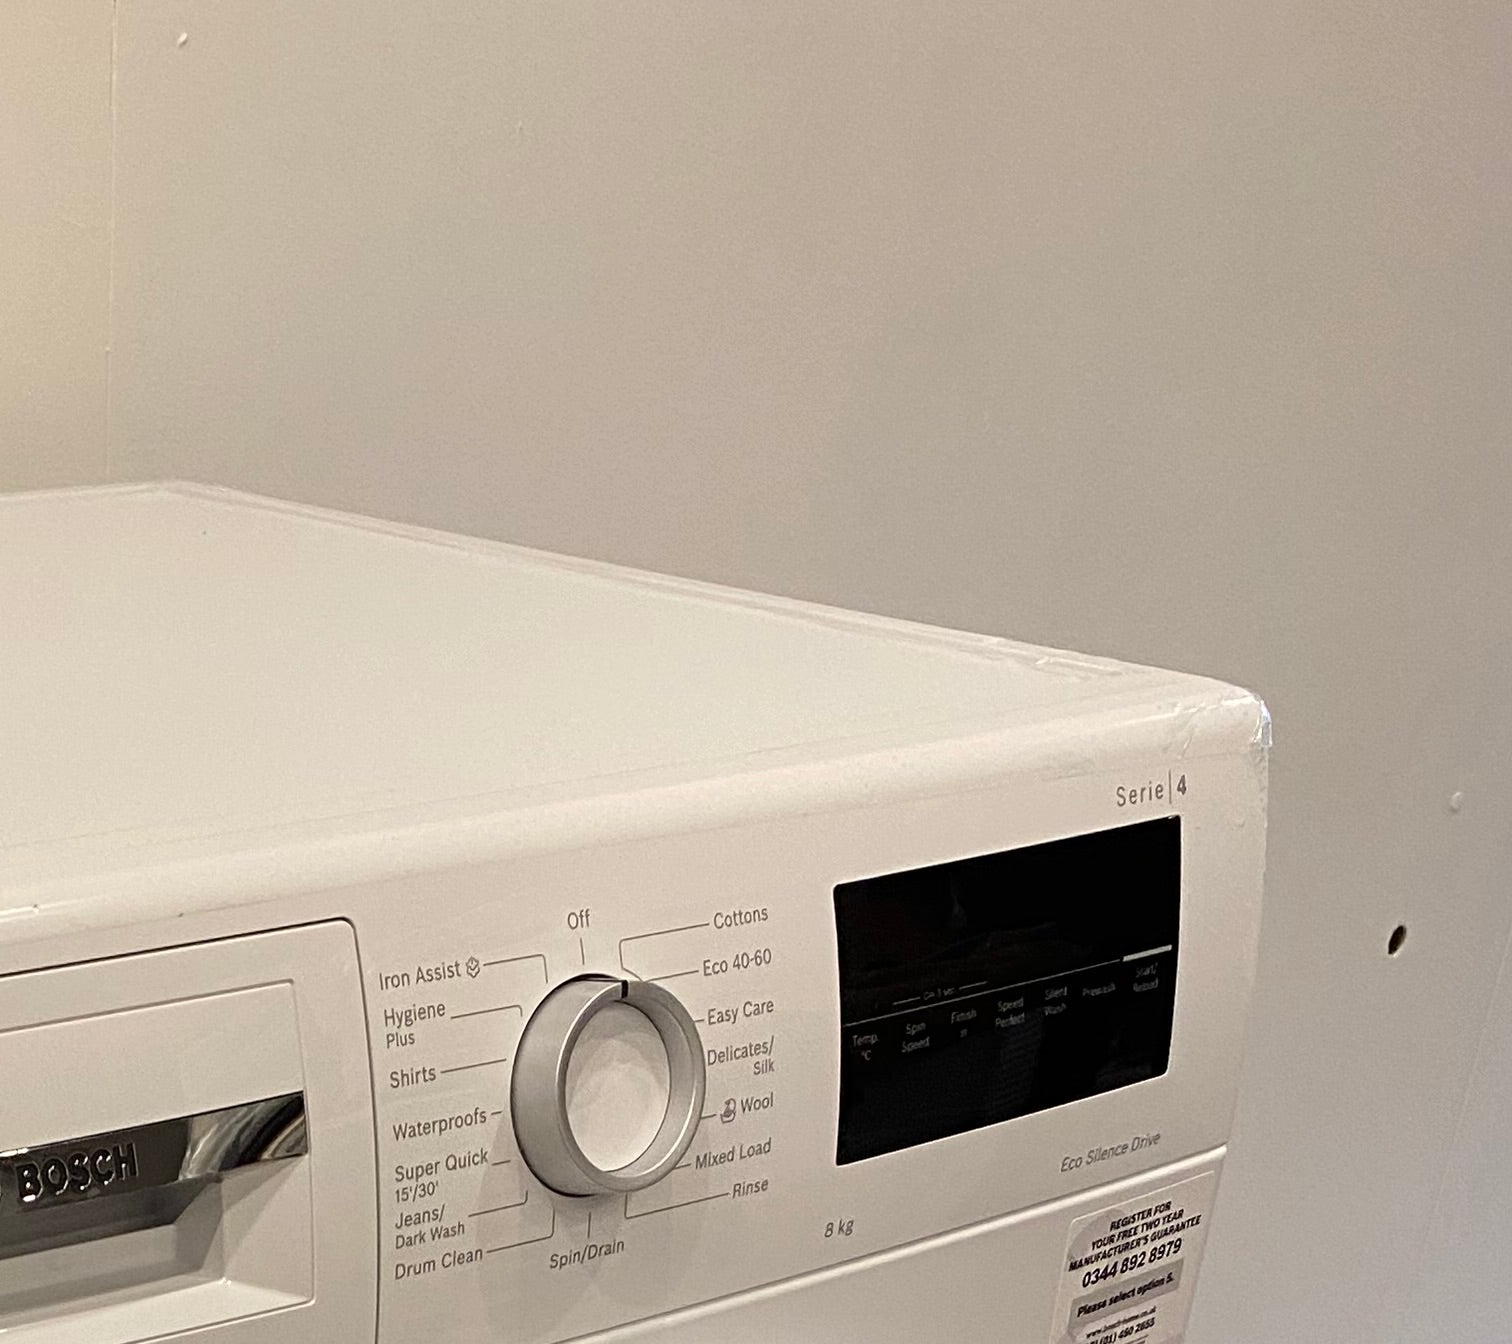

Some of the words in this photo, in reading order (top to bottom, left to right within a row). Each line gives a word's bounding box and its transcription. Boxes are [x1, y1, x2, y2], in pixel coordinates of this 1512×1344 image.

[567, 910, 591, 931] Off
[712, 907, 769, 930] Cottons
[379, 969, 412, 991] Iron
[415, 961, 462, 983] Assist
[702, 957, 729, 977] Eco
[732, 949, 772, 971] 40-60
[383, 1003, 446, 1028] Hygiene
[707, 1007, 739, 1026] Easy
[743, 999, 775, 1018] Care
[386, 1031, 416, 1049] Plus
[706, 1035, 775, 1067] Delicates/
[389, 1065, 436, 1089] Shirts
[753, 1059, 775, 1076] Silk
[740, 1092, 774, 1114] Wool
[392, 1107, 487, 1142] Waterproofs
[395, 1162, 440, 1184] Super
[445, 1147, 489, 1172] Quick
[695, 1148, 735, 1171] Mixed
[739, 1139, 772, 1161] Load
[1060, 1155, 1083, 1174] Eco
[1086, 1141, 1128, 1166] Silence
[1131, 1130, 1161, 1153] Drive
[14, 1142, 138, 1205] BOSCH
[731, 1177, 769, 1199] Rinse
[395, 1205, 445, 1229] Jeans/
[824, 1220, 834, 1238] 8
[837, 1218, 854, 1237] kg
[1091, 1233, 1115, 1251] YOUR
[1116, 1224, 1139, 1239] FREE
[1140, 1217, 1159, 1233] TWO
[1159, 1209, 1184, 1225] YEAR
[1110, 1210, 1151, 1232] REGISTER
[1152, 1200, 1172, 1215] FOR
[395, 1230, 426, 1250] Dark
[429, 1221, 466, 1243] Wash
[1068, 1235, 1149, 1272] MANUFACTURER'S
[1150, 1214, 1202, 1244] GUARANTEE
[394, 1256, 436, 1280] Drum
[440, 1246, 484, 1269] Clean
[549, 1238, 625, 1271] Spin/Drain
[1082, 1261, 1117, 1288] 0344
[1120, 1251, 1146, 1275] 892
[1148, 1238, 1183, 1263] 8979
[1077, 1298, 1107, 1318] Please
[1109, 1287, 1136, 1308] select
[1137, 1276, 1165, 1296] option
